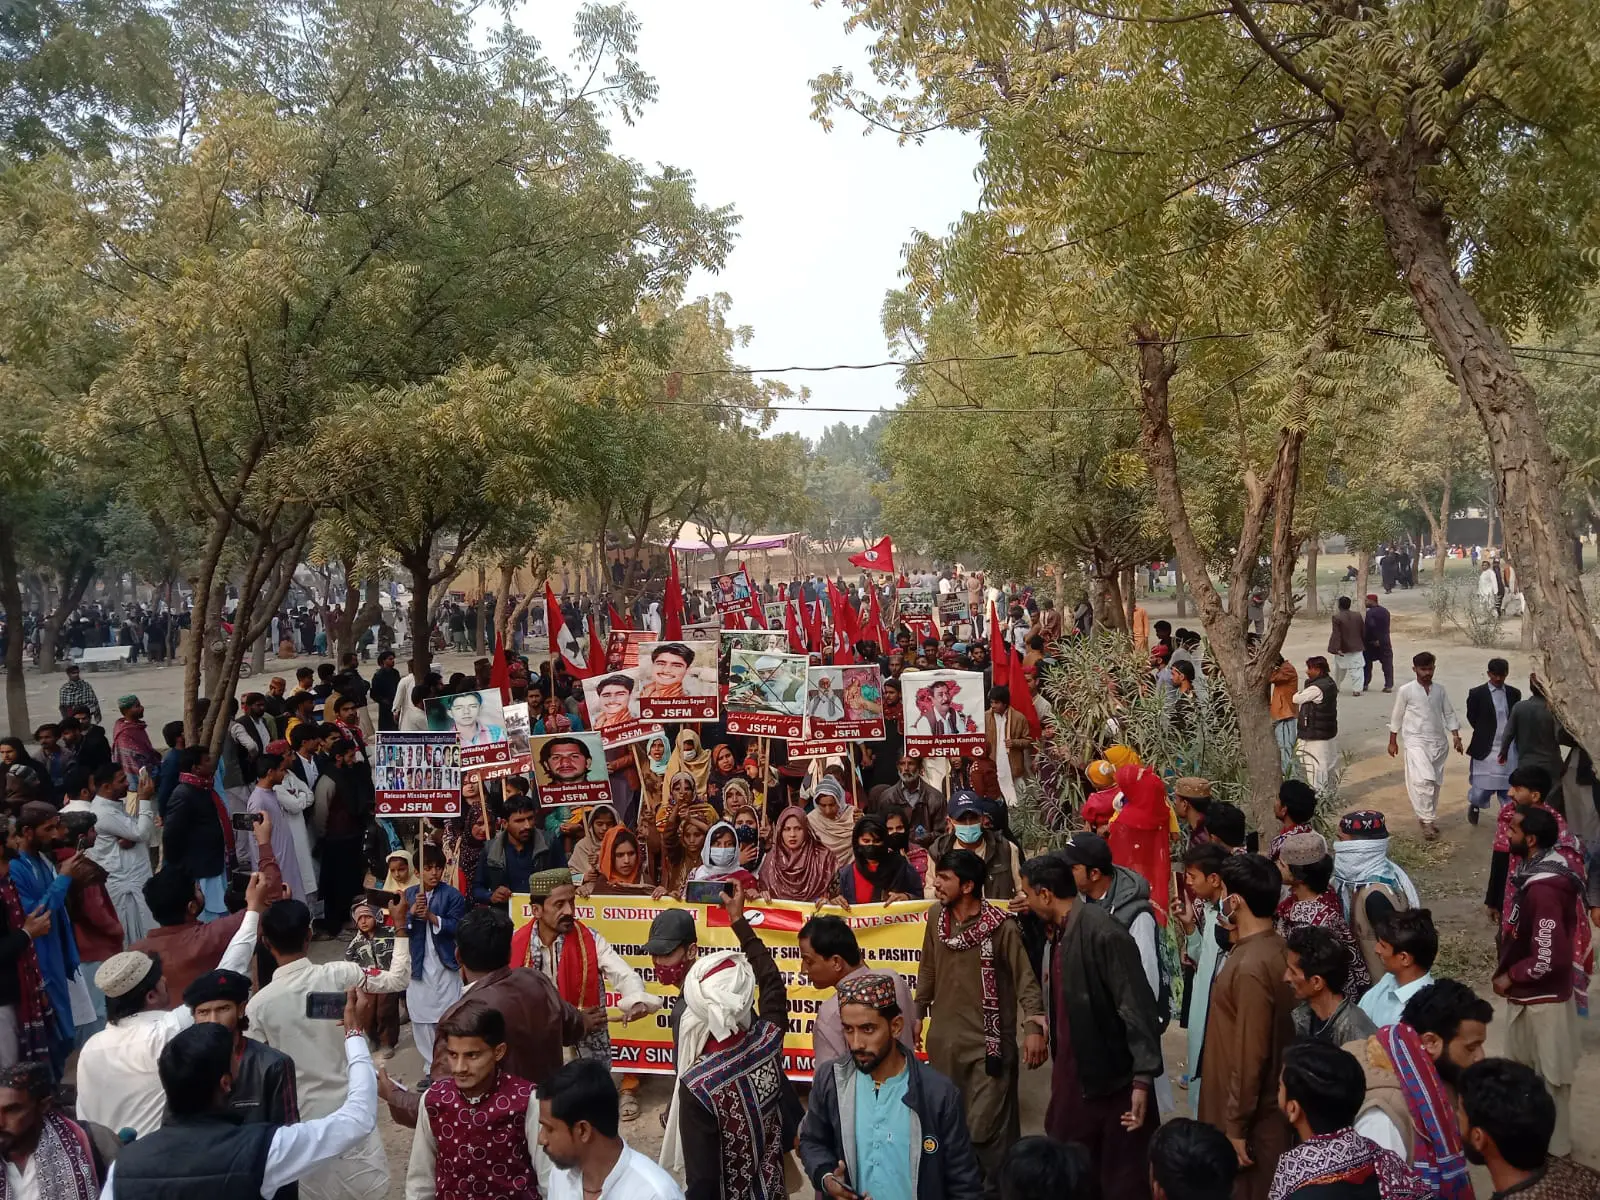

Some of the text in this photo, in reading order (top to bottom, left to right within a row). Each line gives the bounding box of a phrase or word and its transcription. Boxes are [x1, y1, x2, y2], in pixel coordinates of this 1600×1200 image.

[661, 708, 692, 718] JSFM
[616, 728, 642, 741] JSFM
[746, 723, 777, 735] JSFM
[831, 729, 860, 738] JSFM
[804, 746, 827, 755] JSFM
[928, 747, 960, 757] JSFM
[462, 754, 486, 766] SFM
[485, 767, 512, 780] JSFM
[407, 791, 429, 800] Missing
[436, 791, 453, 799] Sindh
[560, 792, 588, 802] JSFM
[400, 802, 433, 812] JSFM
[574, 907, 595, 919] IVE
[848, 917, 880, 929] LIVE
[884, 912, 920, 925] SAIN
[868, 949, 877, 960] &
[610, 1045, 640, 1062] EAY
